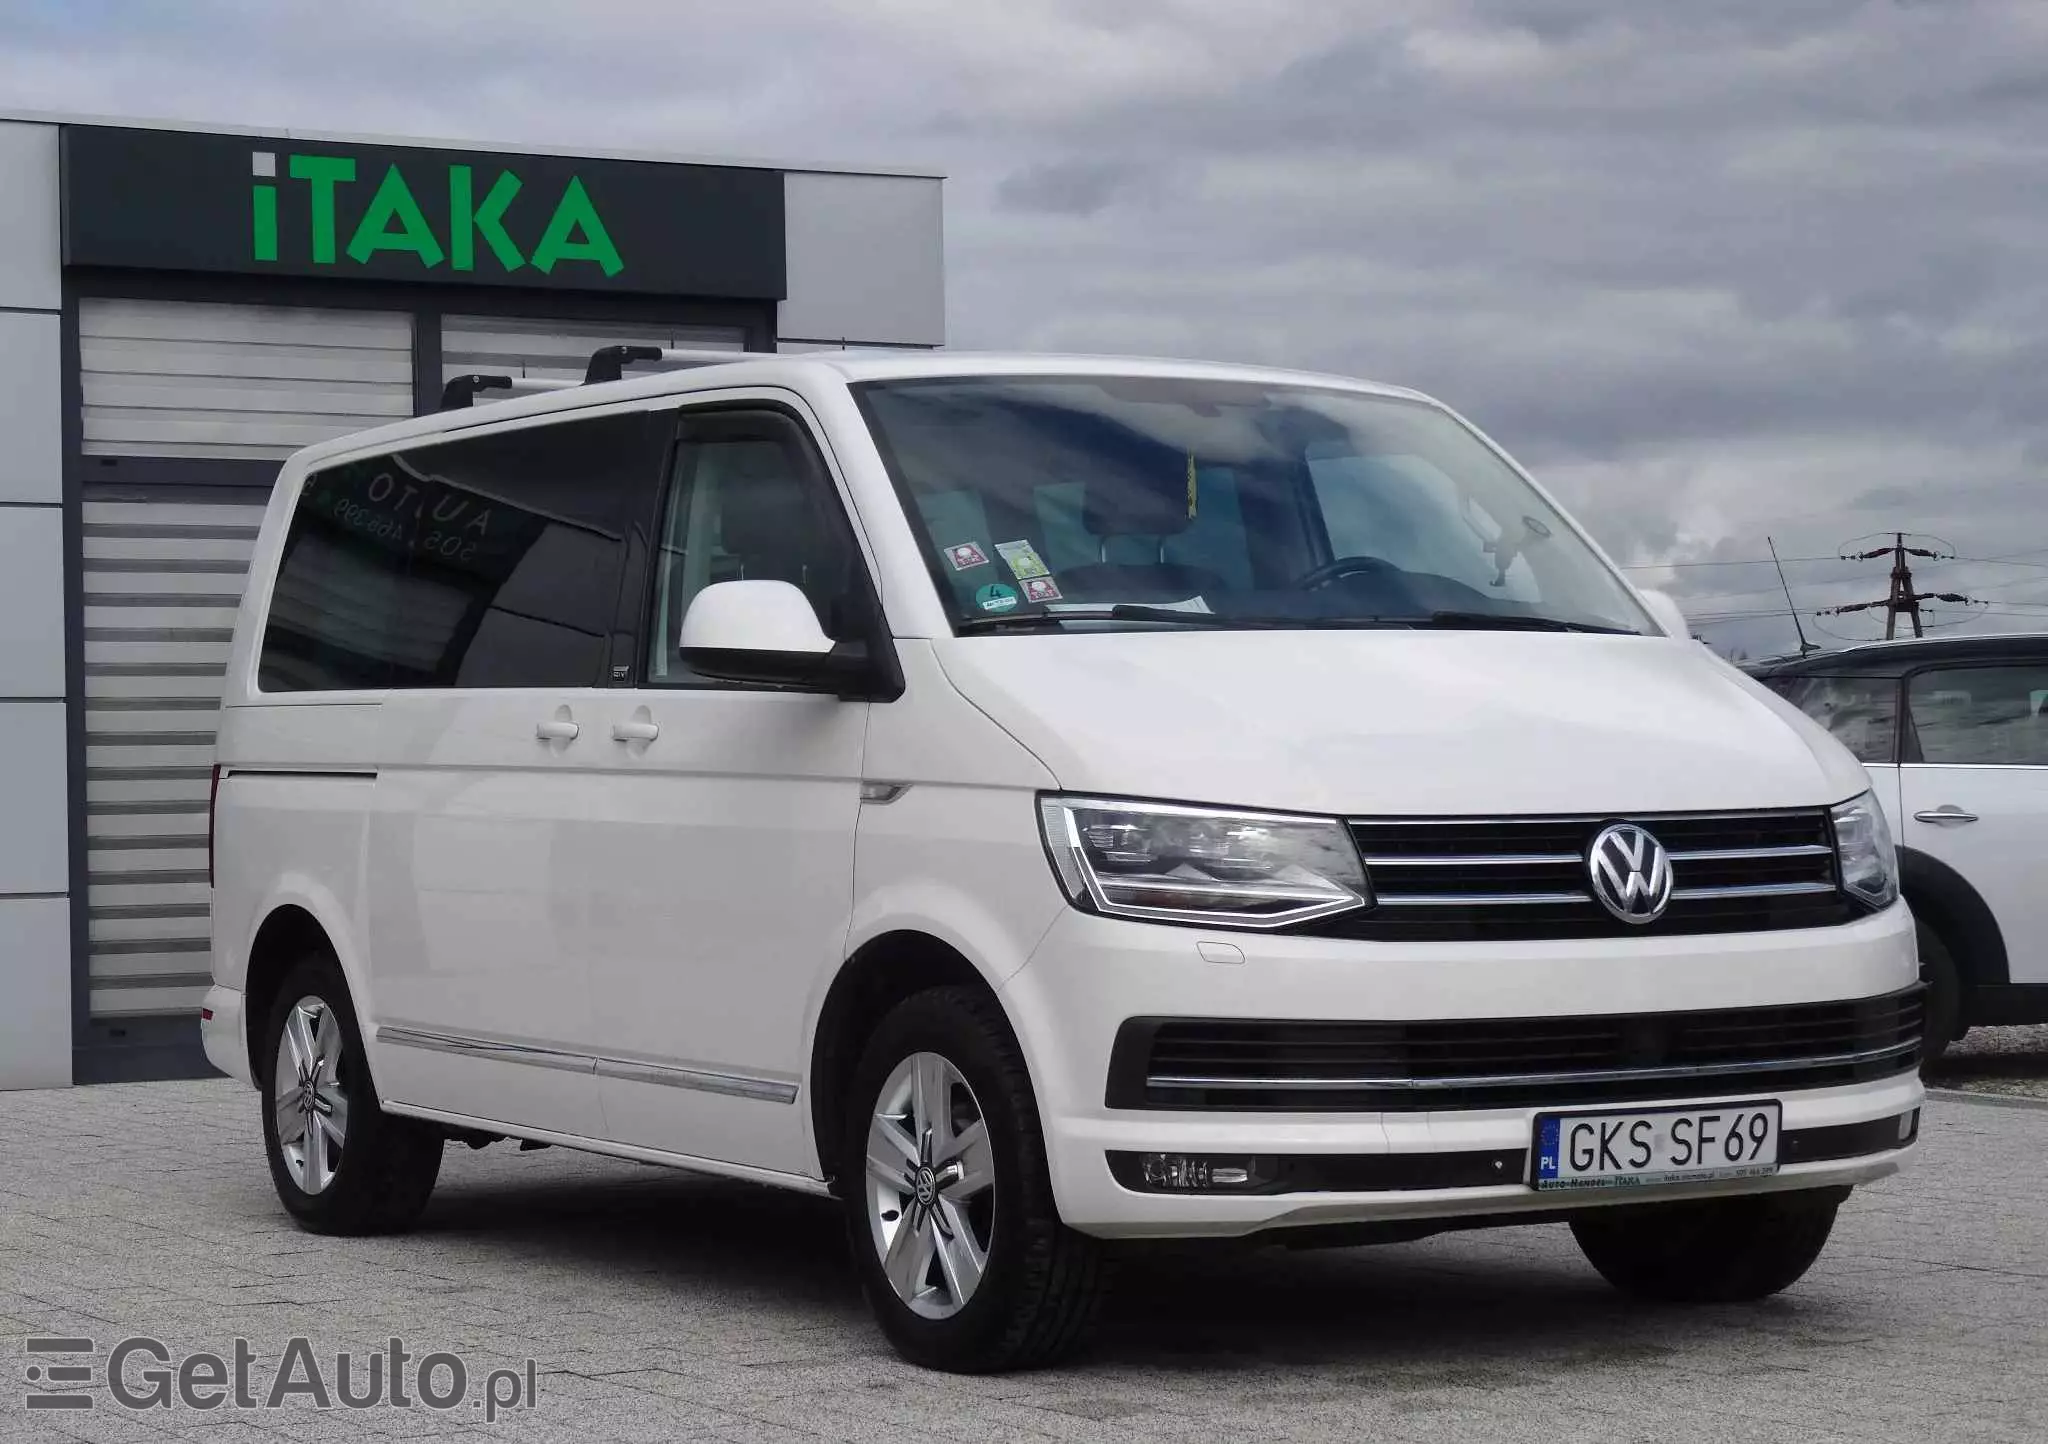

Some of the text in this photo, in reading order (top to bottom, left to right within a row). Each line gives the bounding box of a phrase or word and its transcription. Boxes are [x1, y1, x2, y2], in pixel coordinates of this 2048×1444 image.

[252, 151, 625, 279] iTAKA
[1540, 1157, 1556, 1170] PL
[1569, 1112, 1769, 1172] GKS SF69
